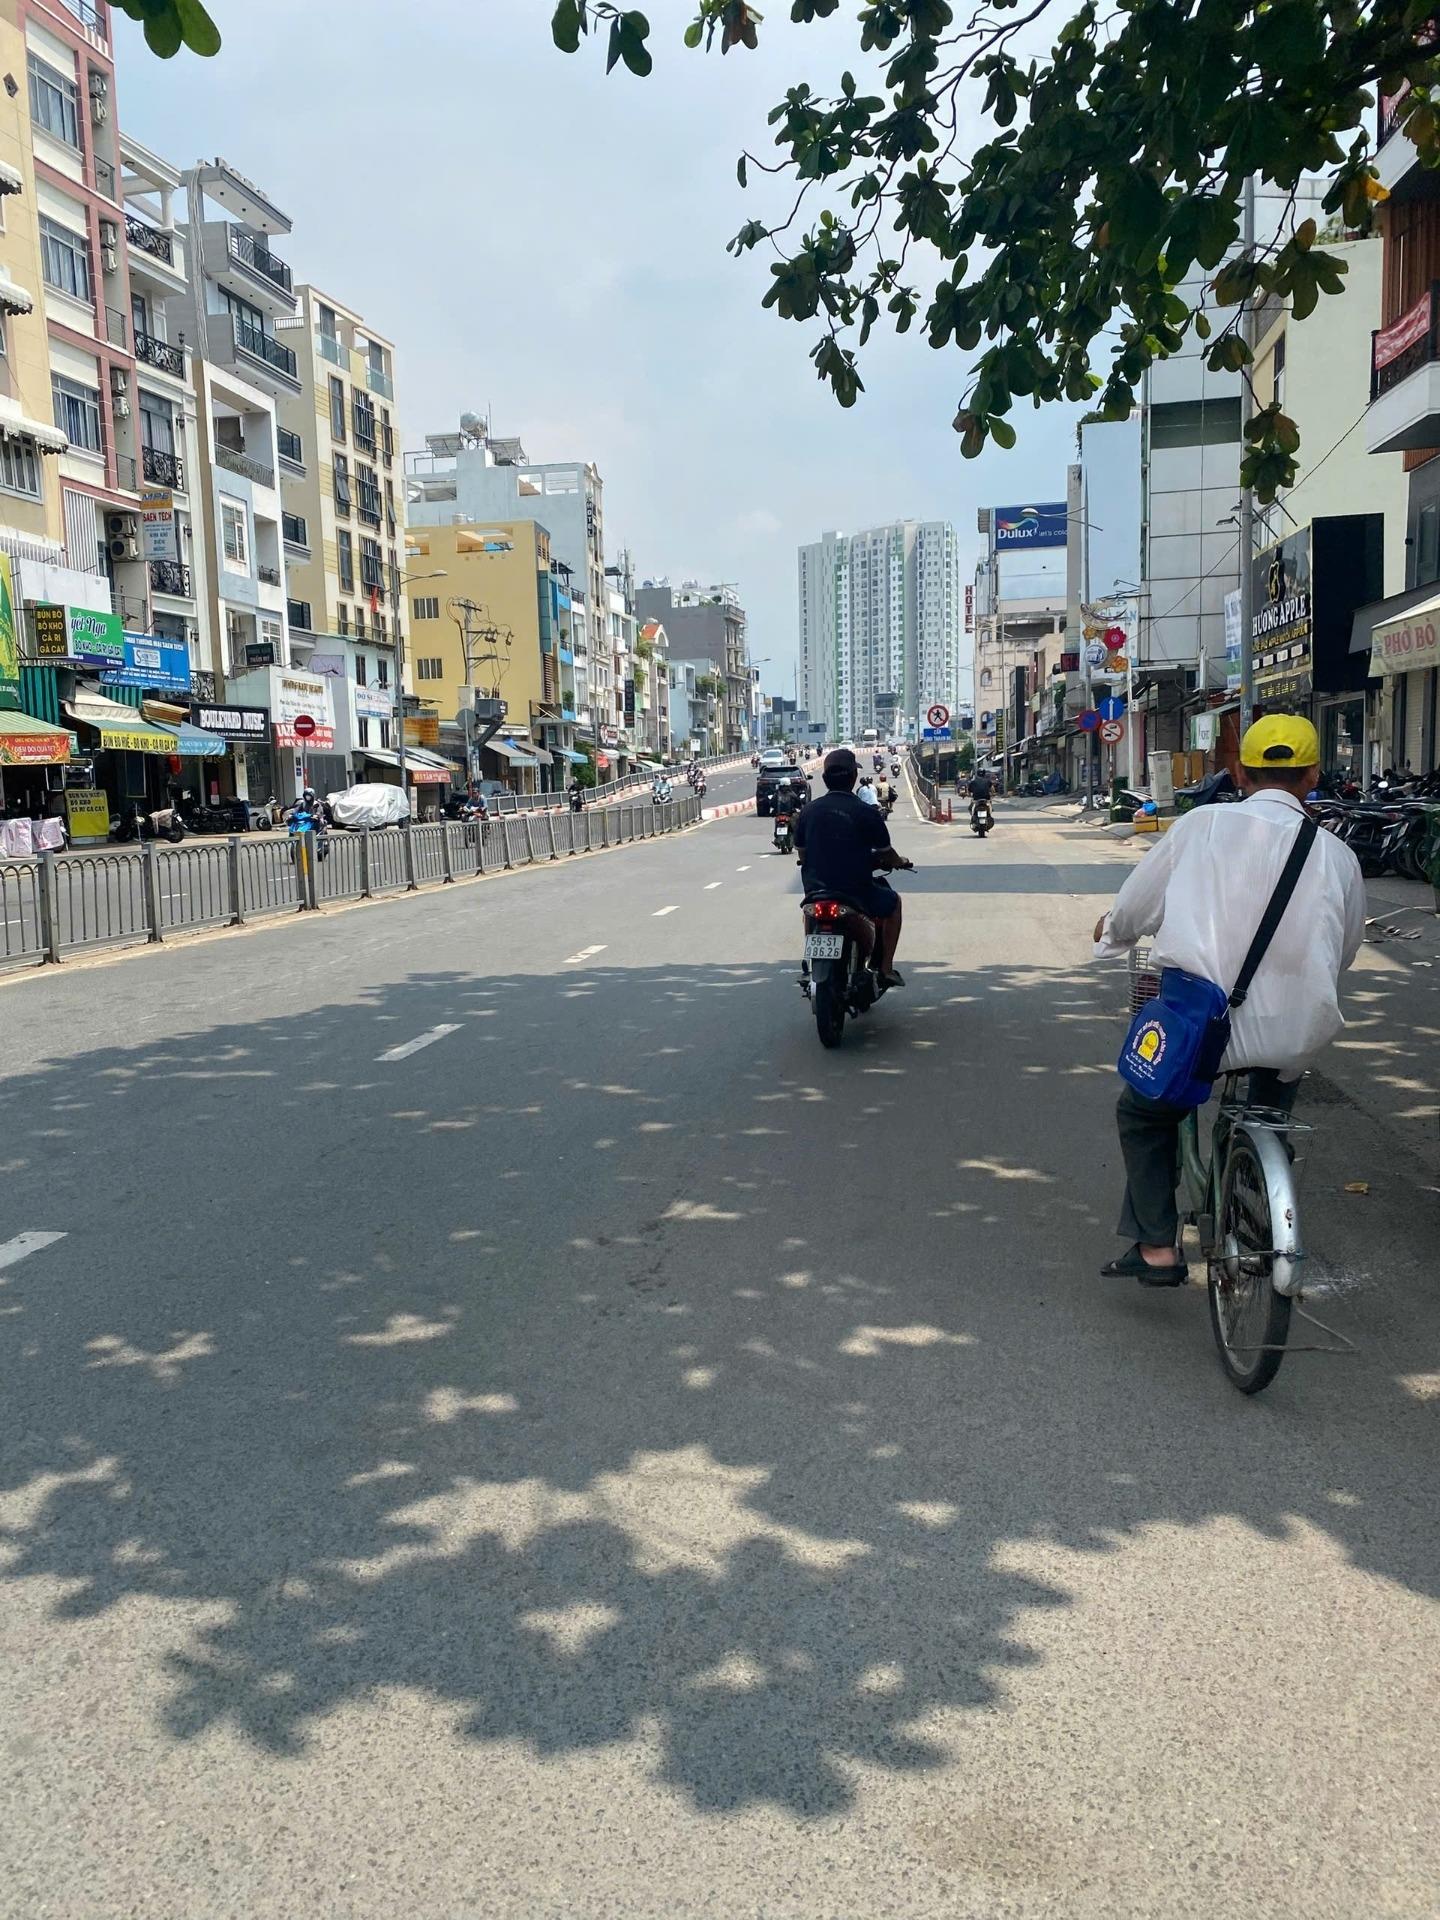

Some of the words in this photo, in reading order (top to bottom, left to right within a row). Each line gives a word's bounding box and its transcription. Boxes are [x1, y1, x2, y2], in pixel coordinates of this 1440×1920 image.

[997, 528, 1033, 539] Dulux
[37, 609, 52, 619] BÚN
[52, 609, 63, 619] BÒ
[1279, 594, 1306, 626] APPLE
[37, 620, 48, 630] BÒ
[48, 622, 64, 630] KHO
[86, 616, 107, 639] Nga
[42, 631, 53, 642] CÀ
[54, 634, 61, 642] RI
[40, 643, 51, 654] GÀ
[51, 645, 65, 654] CAY
[199, 709, 241, 729] BOULEVARD
[242, 712, 265, 731] MUSIC
[811, 936, 837, 946] 59-S1
